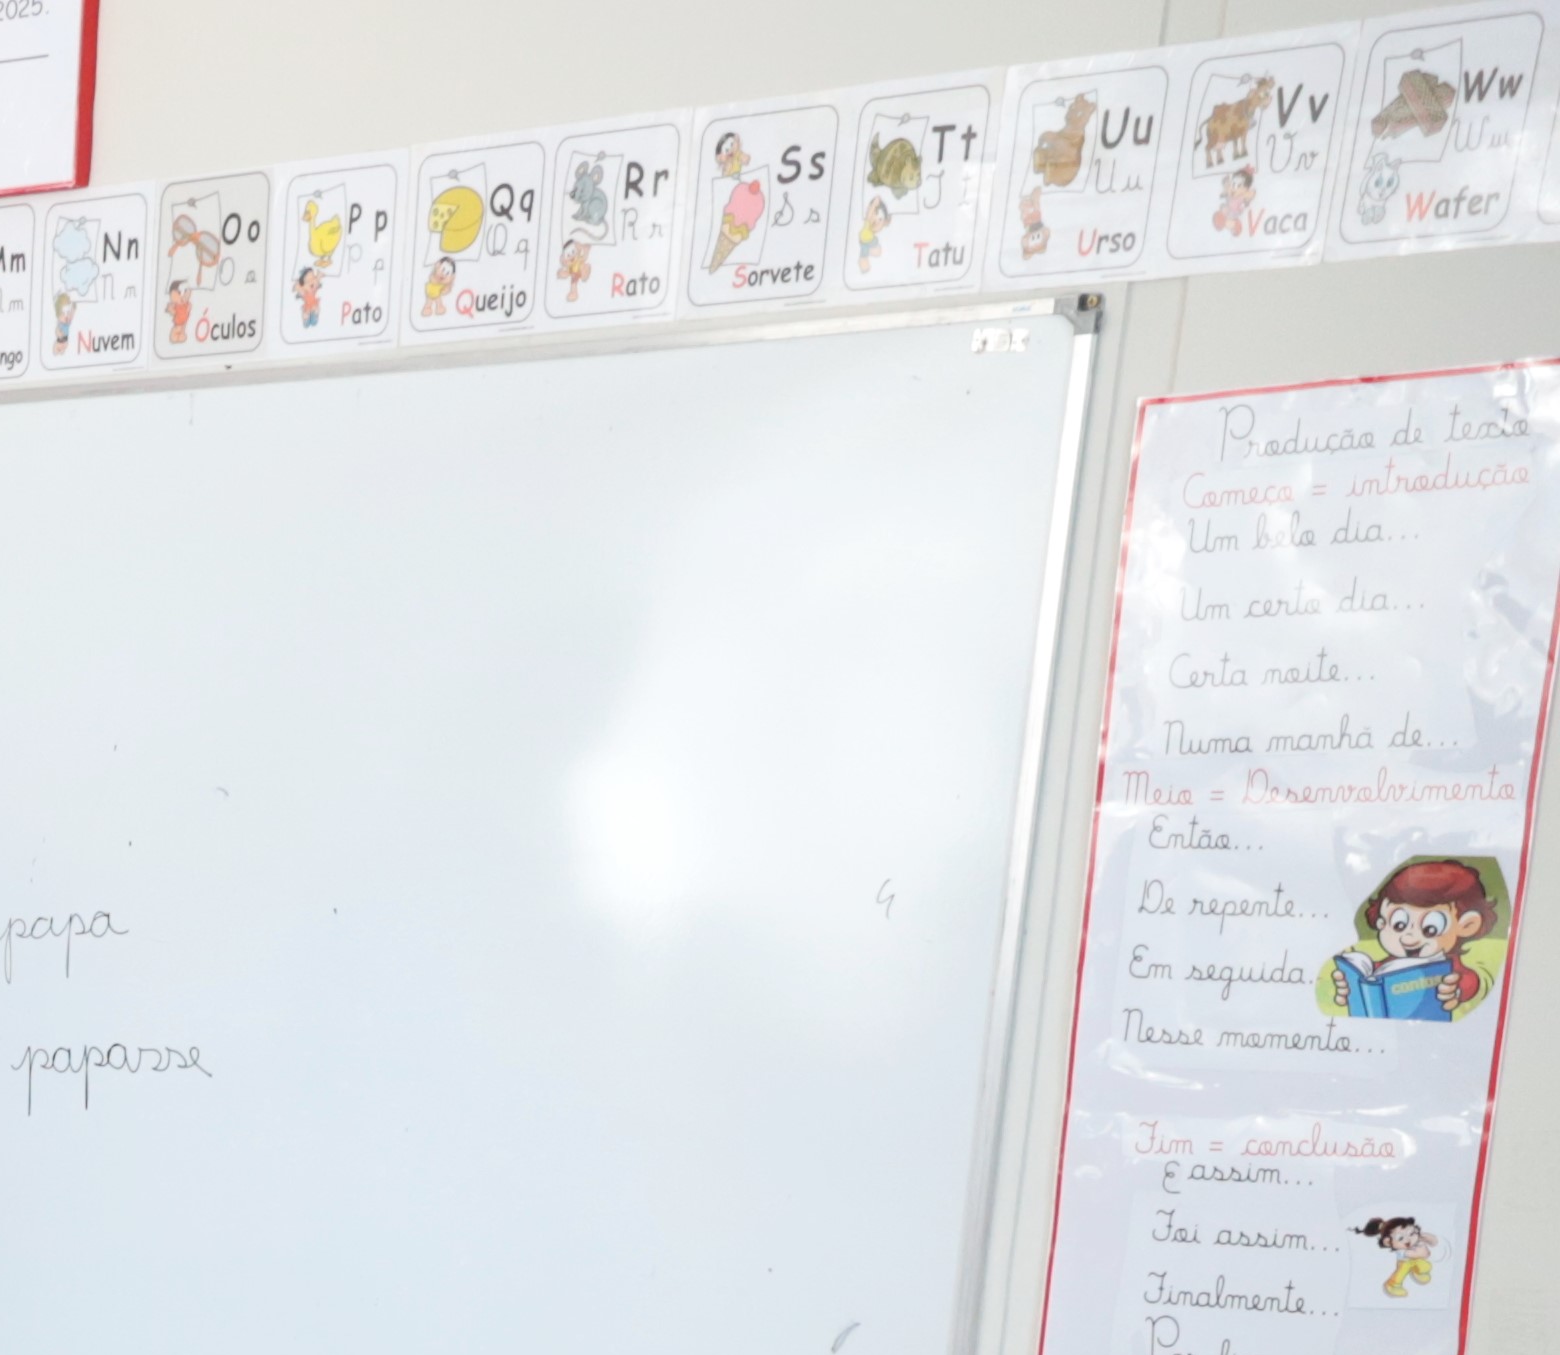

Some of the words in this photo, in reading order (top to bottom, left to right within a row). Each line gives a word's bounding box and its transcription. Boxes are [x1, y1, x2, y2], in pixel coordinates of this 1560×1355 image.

[1245, 208, 1308, 238] Vaca
[1406, 187, 1500, 224] Wafer
[913, 241, 965, 269] Tatu
[1077, 228, 1136, 258] Urso
[610, 272, 661, 299] Rato
[731, 260, 815, 289] Sorvete
[341, 301, 383, 327] Pato
[454, 282, 528, 318] Queijo
[76, 330, 135, 355] Nuvem
[195, 307, 257, 342] Óculos
[1218, 402, 1376, 462] Produção
[1389, 407, 1425, 448] de
[1442, 402, 1532, 444] texto
[1182, 472, 1294, 511] Começo
[1345, 452, 1531, 500] introdução
[1188, 518, 1240, 555] Um
[1254, 510, 1317, 550] belo
[1181, 587, 1231, 623] Um
[1243, 578, 1322, 619] certo
[1168, 650, 1249, 690] Certa
[1162, 719, 1254, 756] Numa
[1265, 714, 1374, 753] manhã
[1122, 768, 1195, 807] Meio
[1241, 764, 1516, 806] Desenvolvimento
[1136, 877, 1176, 918] De
[1128, 944, 1174, 983] Em
[1122, 1007, 1204, 1048] Nesse
[1133, 1118, 1196, 1158] Fim
[1240, 1120, 1398, 1161] conclusão
[1151, 1208, 1203, 1246] Foi
